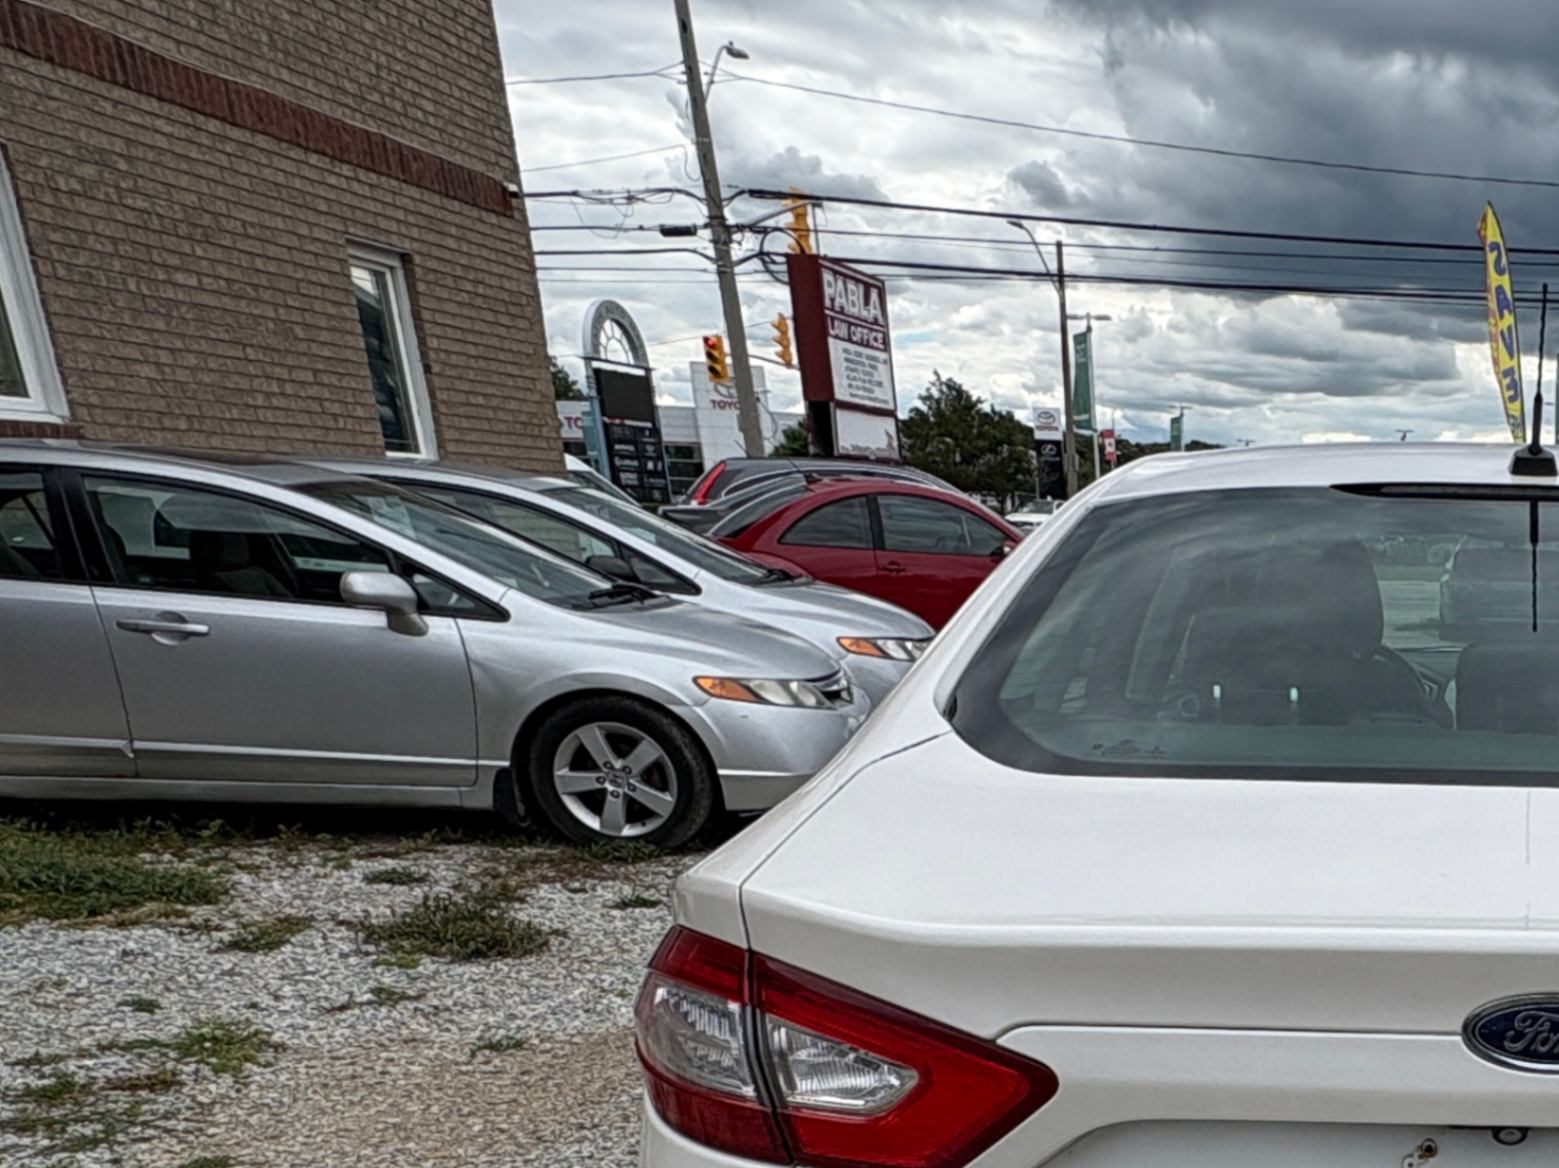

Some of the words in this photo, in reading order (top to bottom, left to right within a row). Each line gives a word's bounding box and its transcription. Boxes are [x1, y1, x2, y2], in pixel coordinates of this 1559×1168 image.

[821, 268, 885, 324] PABLA
[827, 317, 849, 339] LAW
[850, 325, 885, 349] OFFICE
[711, 399, 741, 410] TOYO
